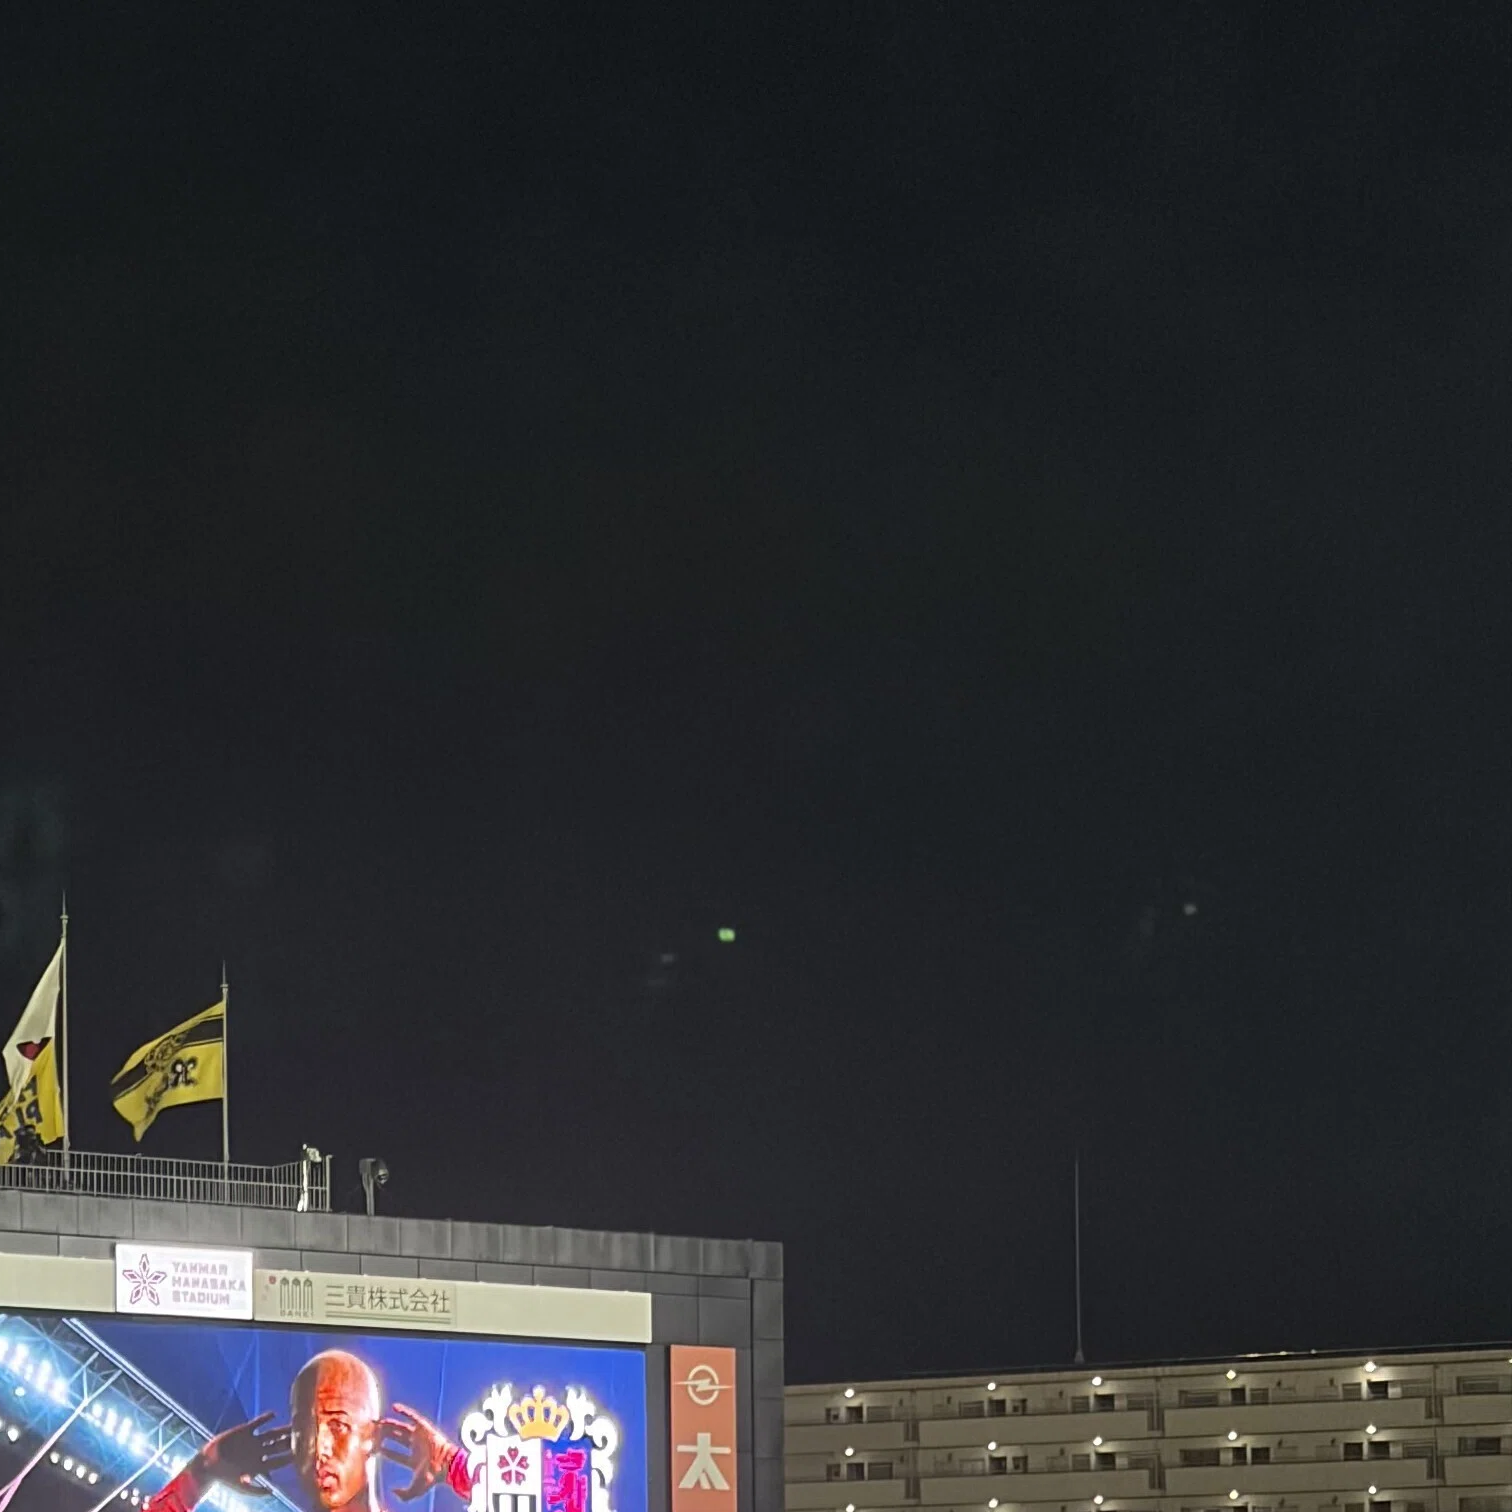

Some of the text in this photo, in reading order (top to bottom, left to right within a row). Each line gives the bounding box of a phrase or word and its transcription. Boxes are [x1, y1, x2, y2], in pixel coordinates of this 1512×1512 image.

[172, 1262, 227, 1276] YANMAR
[172, 1276, 246, 1292] HANASAKA
[172, 1291, 230, 1305] STADIUM
[325, 1284, 451, 1314] 三貴株式会社
